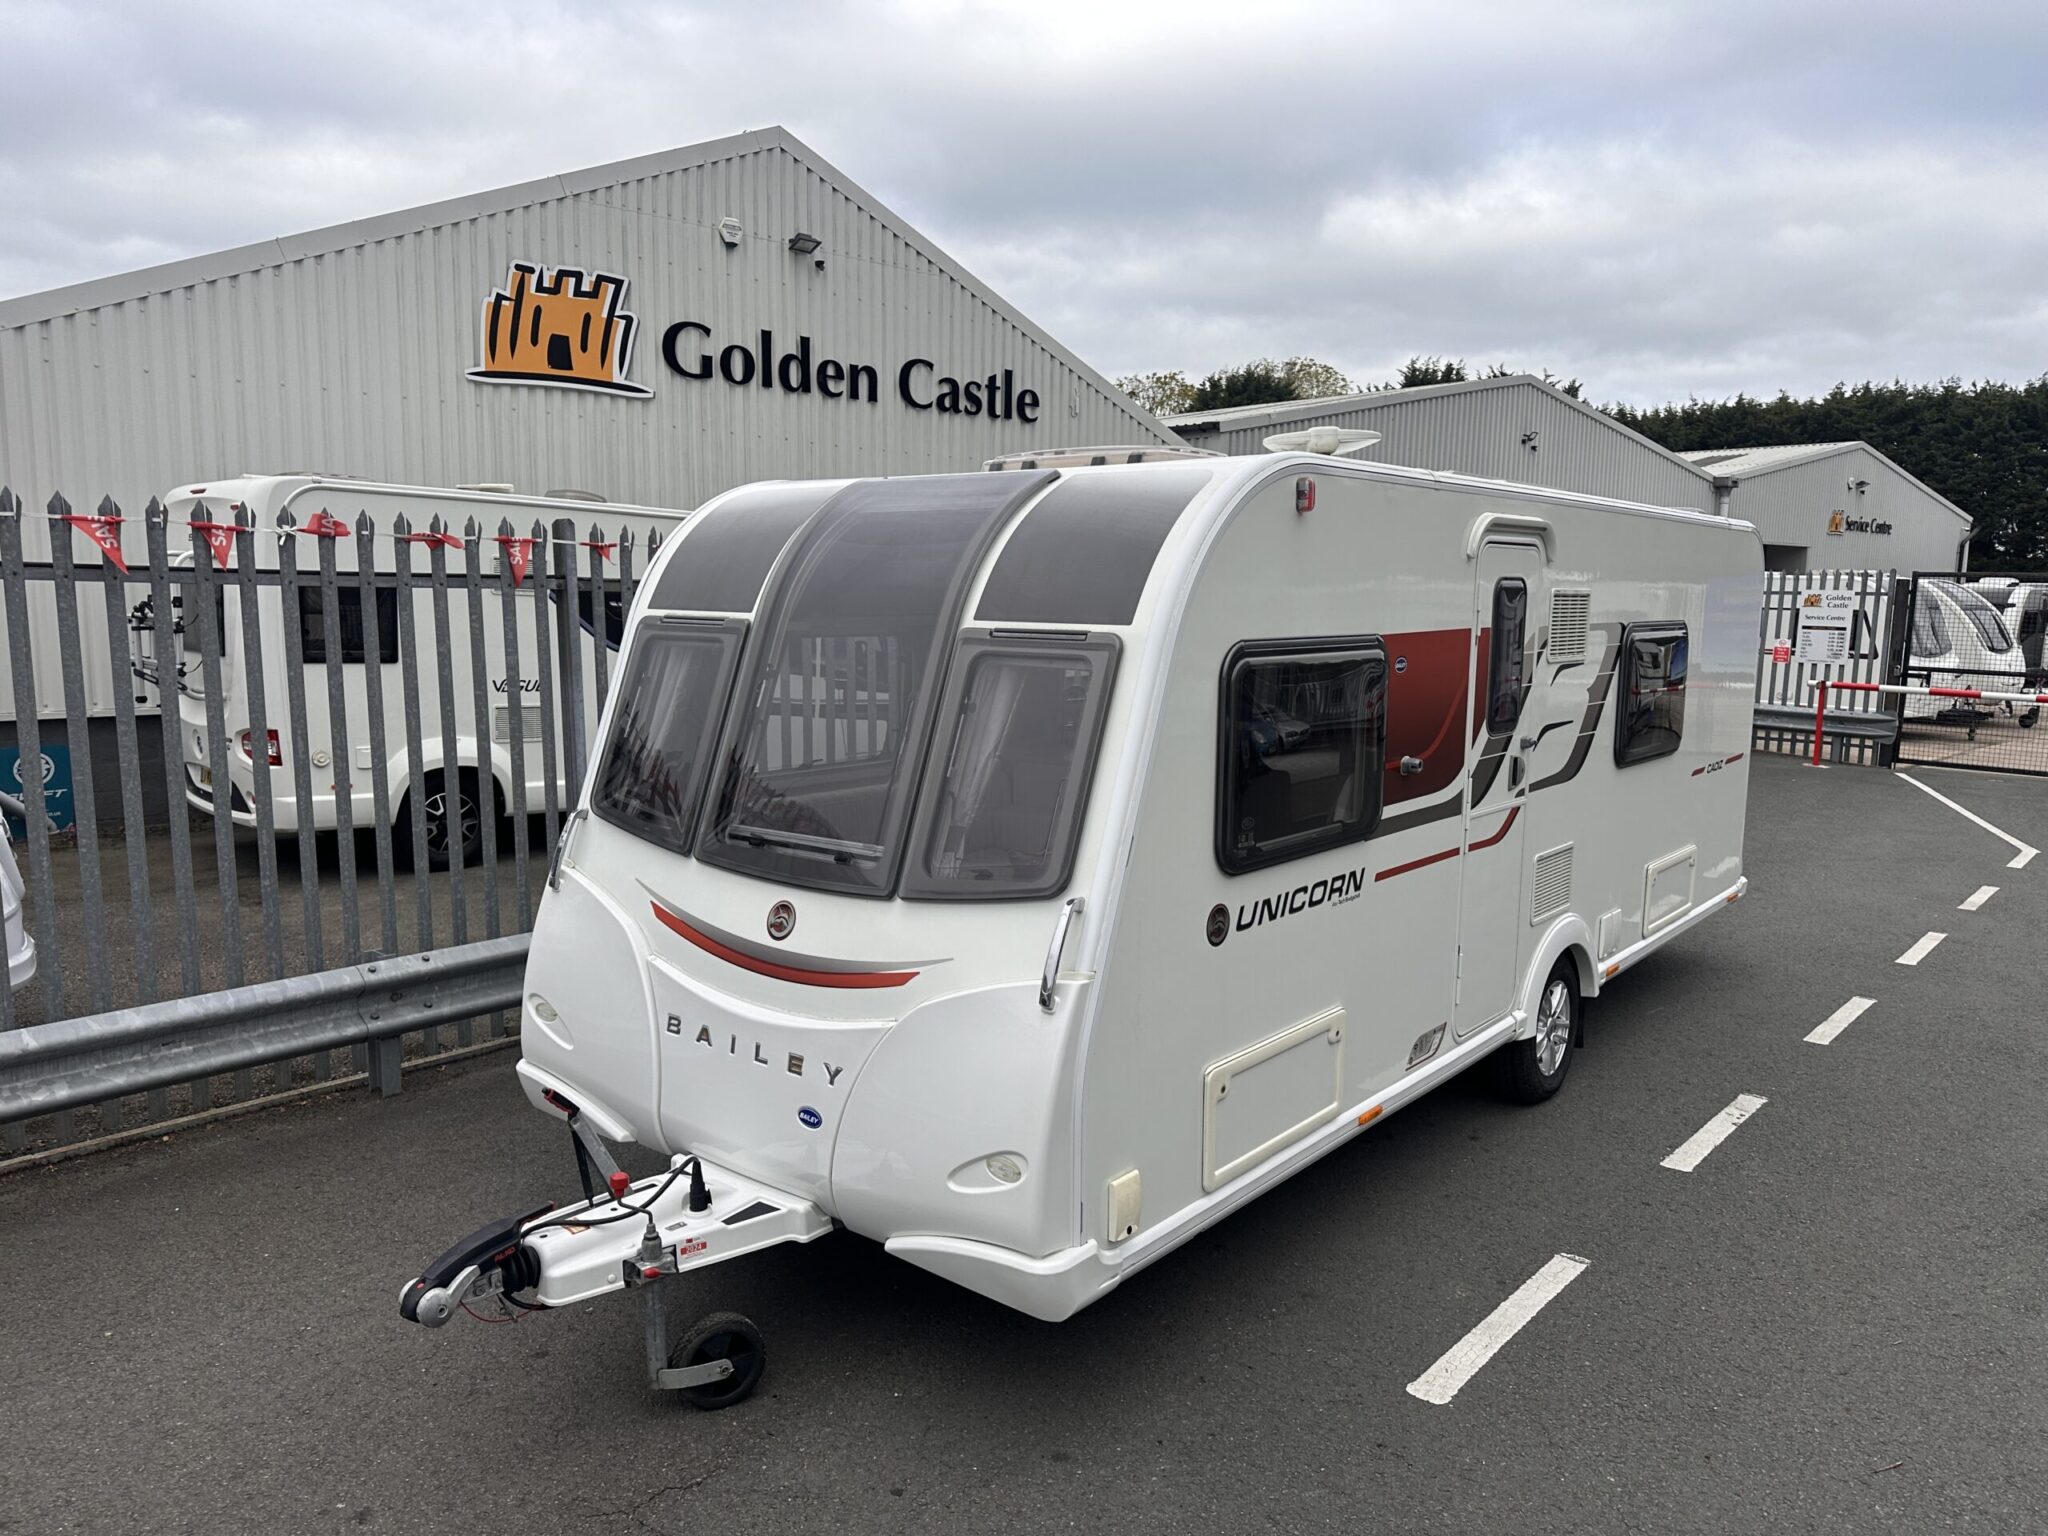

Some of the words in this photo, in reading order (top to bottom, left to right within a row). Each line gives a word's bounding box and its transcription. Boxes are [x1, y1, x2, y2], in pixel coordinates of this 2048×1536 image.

[662, 320, 879, 403] Golden
[899, 357, 1041, 423] Castle
[1845, 514, 1870, 533] Service
[1870, 517, 1892, 535] Centre
[1804, 613, 1825, 621] Service
[1236, 867, 1366, 932] UNICORN
[665, 1012, 844, 1087] BAILEY
[799, 1111, 819, 1124] BAILEY
